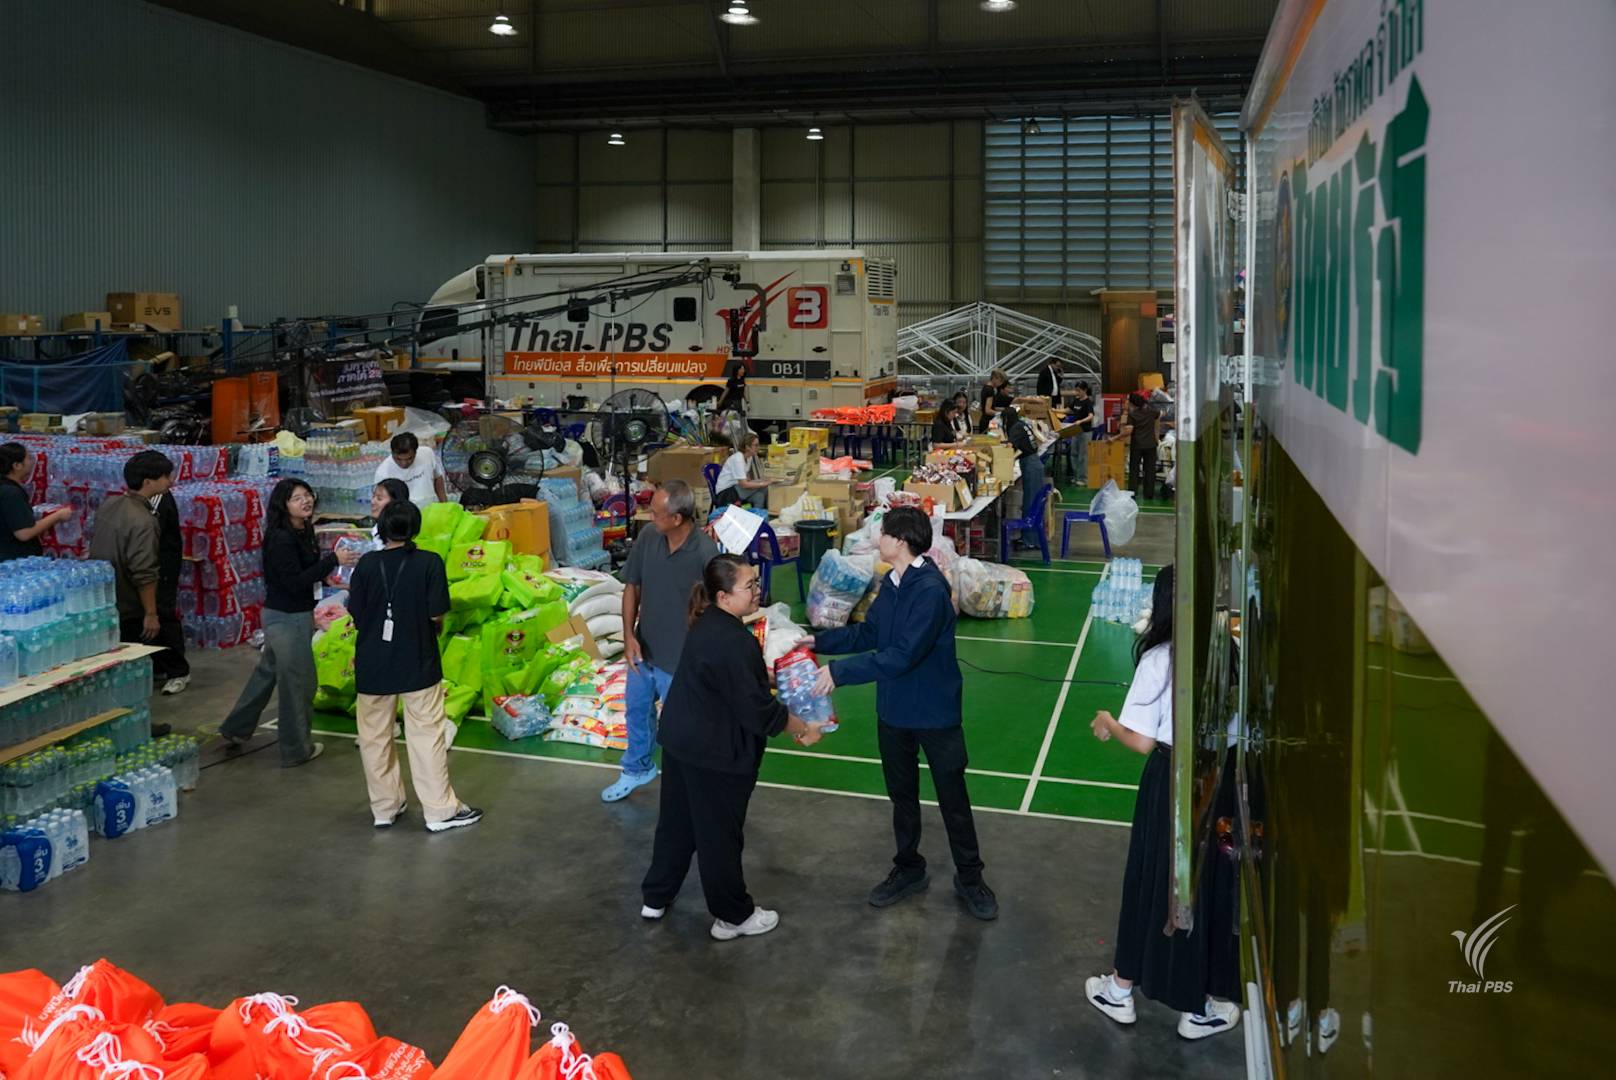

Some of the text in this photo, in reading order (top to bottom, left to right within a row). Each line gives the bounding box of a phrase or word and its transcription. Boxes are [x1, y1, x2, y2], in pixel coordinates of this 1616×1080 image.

[144, 306, 171, 316] EVS
[794, 290, 822, 324] 3
[505, 320, 674, 355] Thai PBS
[512, 354, 708, 374] ไทยพีบีเอส สื่อเพื่อการเปลี่ยนแปลง
[771, 361, 803, 375] OB1
[116, 809, 127, 823] 3
[33, 858, 44, 873] 3
